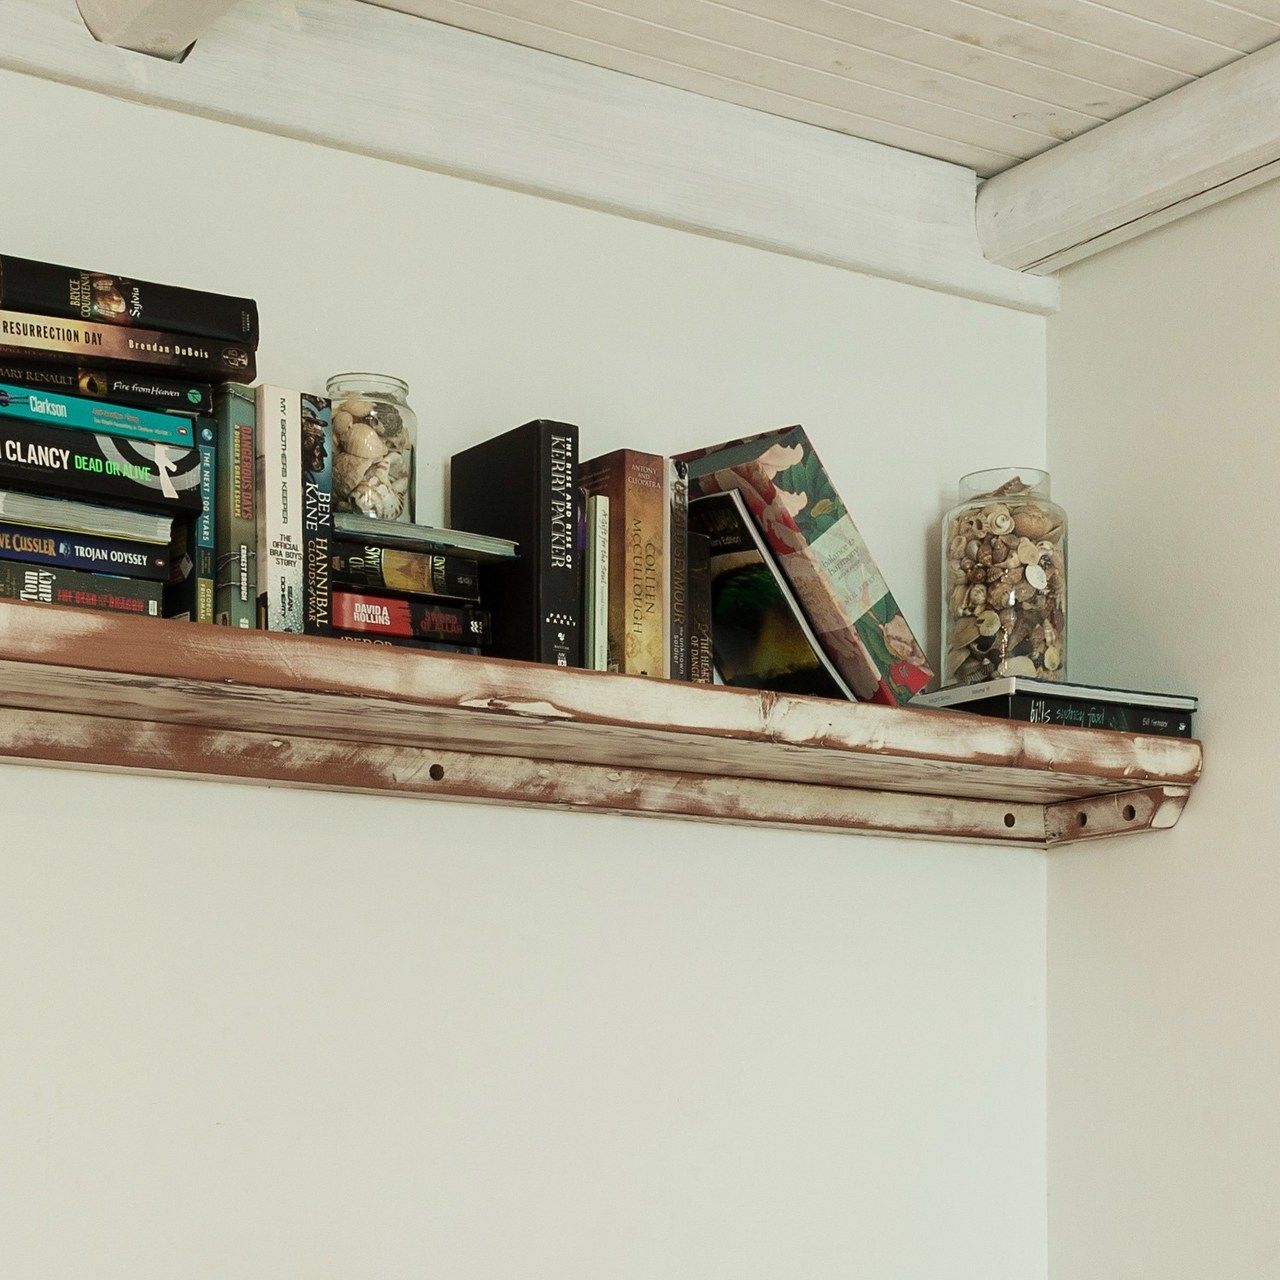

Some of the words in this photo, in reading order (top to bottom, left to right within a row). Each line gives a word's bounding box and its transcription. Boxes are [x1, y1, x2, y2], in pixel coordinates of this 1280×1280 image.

[70, 278, 81, 308] BRYCE
[80, 272, 91, 319] COURTENAY
[129, 286, 141, 319] Sylvia
[1, 319, 81, 344] RESURRECTION
[83, 327, 104, 347] DAY
[127, 338, 171, 354] Brendan
[174, 340, 210, 360] DuBois
[25, 367, 77, 388] RENAULT
[112, 380, 131, 394] Fire
[131, 382, 151, 397] from
[150, 385, 181, 399] Heaven
[28, 394, 68, 419] Clarkson
[279, 397, 287, 416] MY
[5, 439, 71, 471] CLANCY
[73, 454, 104, 475] DEAD
[104, 459, 121, 477] OR
[119, 462, 153, 482] ALIVE
[241, 425, 253, 490] DANGEROUS
[279, 418, 288, 478] BROTHERS
[233, 464, 241, 490] GREAT
[550, 434, 566, 497] KERRY
[631, 463, 658, 475] ANTONY
[627, 477, 662, 489] CLEOPATRA
[203, 495, 211, 511] 100
[233, 489, 241, 519] ESCAPE
[241, 490, 253, 521] DAYS
[281, 480, 289, 525] KEEPER
[305, 481, 319, 532] KANE
[317, 491, 332, 528] BEN
[673, 479, 686, 545] GERALD
[202, 511, 210, 542] YEARS
[279, 533, 292, 543] THE
[550, 499, 566, 569] PACKER
[11, 533, 57, 557] CUSSLER
[73, 545, 109, 562] TROJAN
[109, 549, 149, 567] ODYSSEY
[269, 548, 284, 558] BRA
[284, 551, 303, 560] BOYS
[272, 540, 300, 552] OFFICIAL
[599, 535, 608, 548] for
[275, 557, 297, 568] STORY
[308, 541, 317, 584] CLOUDS
[565, 554, 572, 570] OF
[600, 549, 608, 564] the
[19, 570, 40, 602] Tom
[315, 537, 329, 628] HANNIBAL
[600, 564, 608, 585] Soul
[644, 542, 656, 615] COLLEEN
[673, 547, 686, 625] SEYMOUR
[307, 597, 317, 622] WAR
[353, 602, 381, 615] DAVID
[381, 606, 389, 615] A
[353, 611, 391, 627] ROLLINS
[549, 612, 574, 622] PAUL
[545, 616, 578, 627] BARRY
[672, 634, 680, 665] soldier
[690, 635, 699, 648] OF
[699, 637, 710, 655] THE
[1030, 700, 1052, 724] bills
[1056, 704, 1085, 728] sydney
[1087, 707, 1106, 728] food
